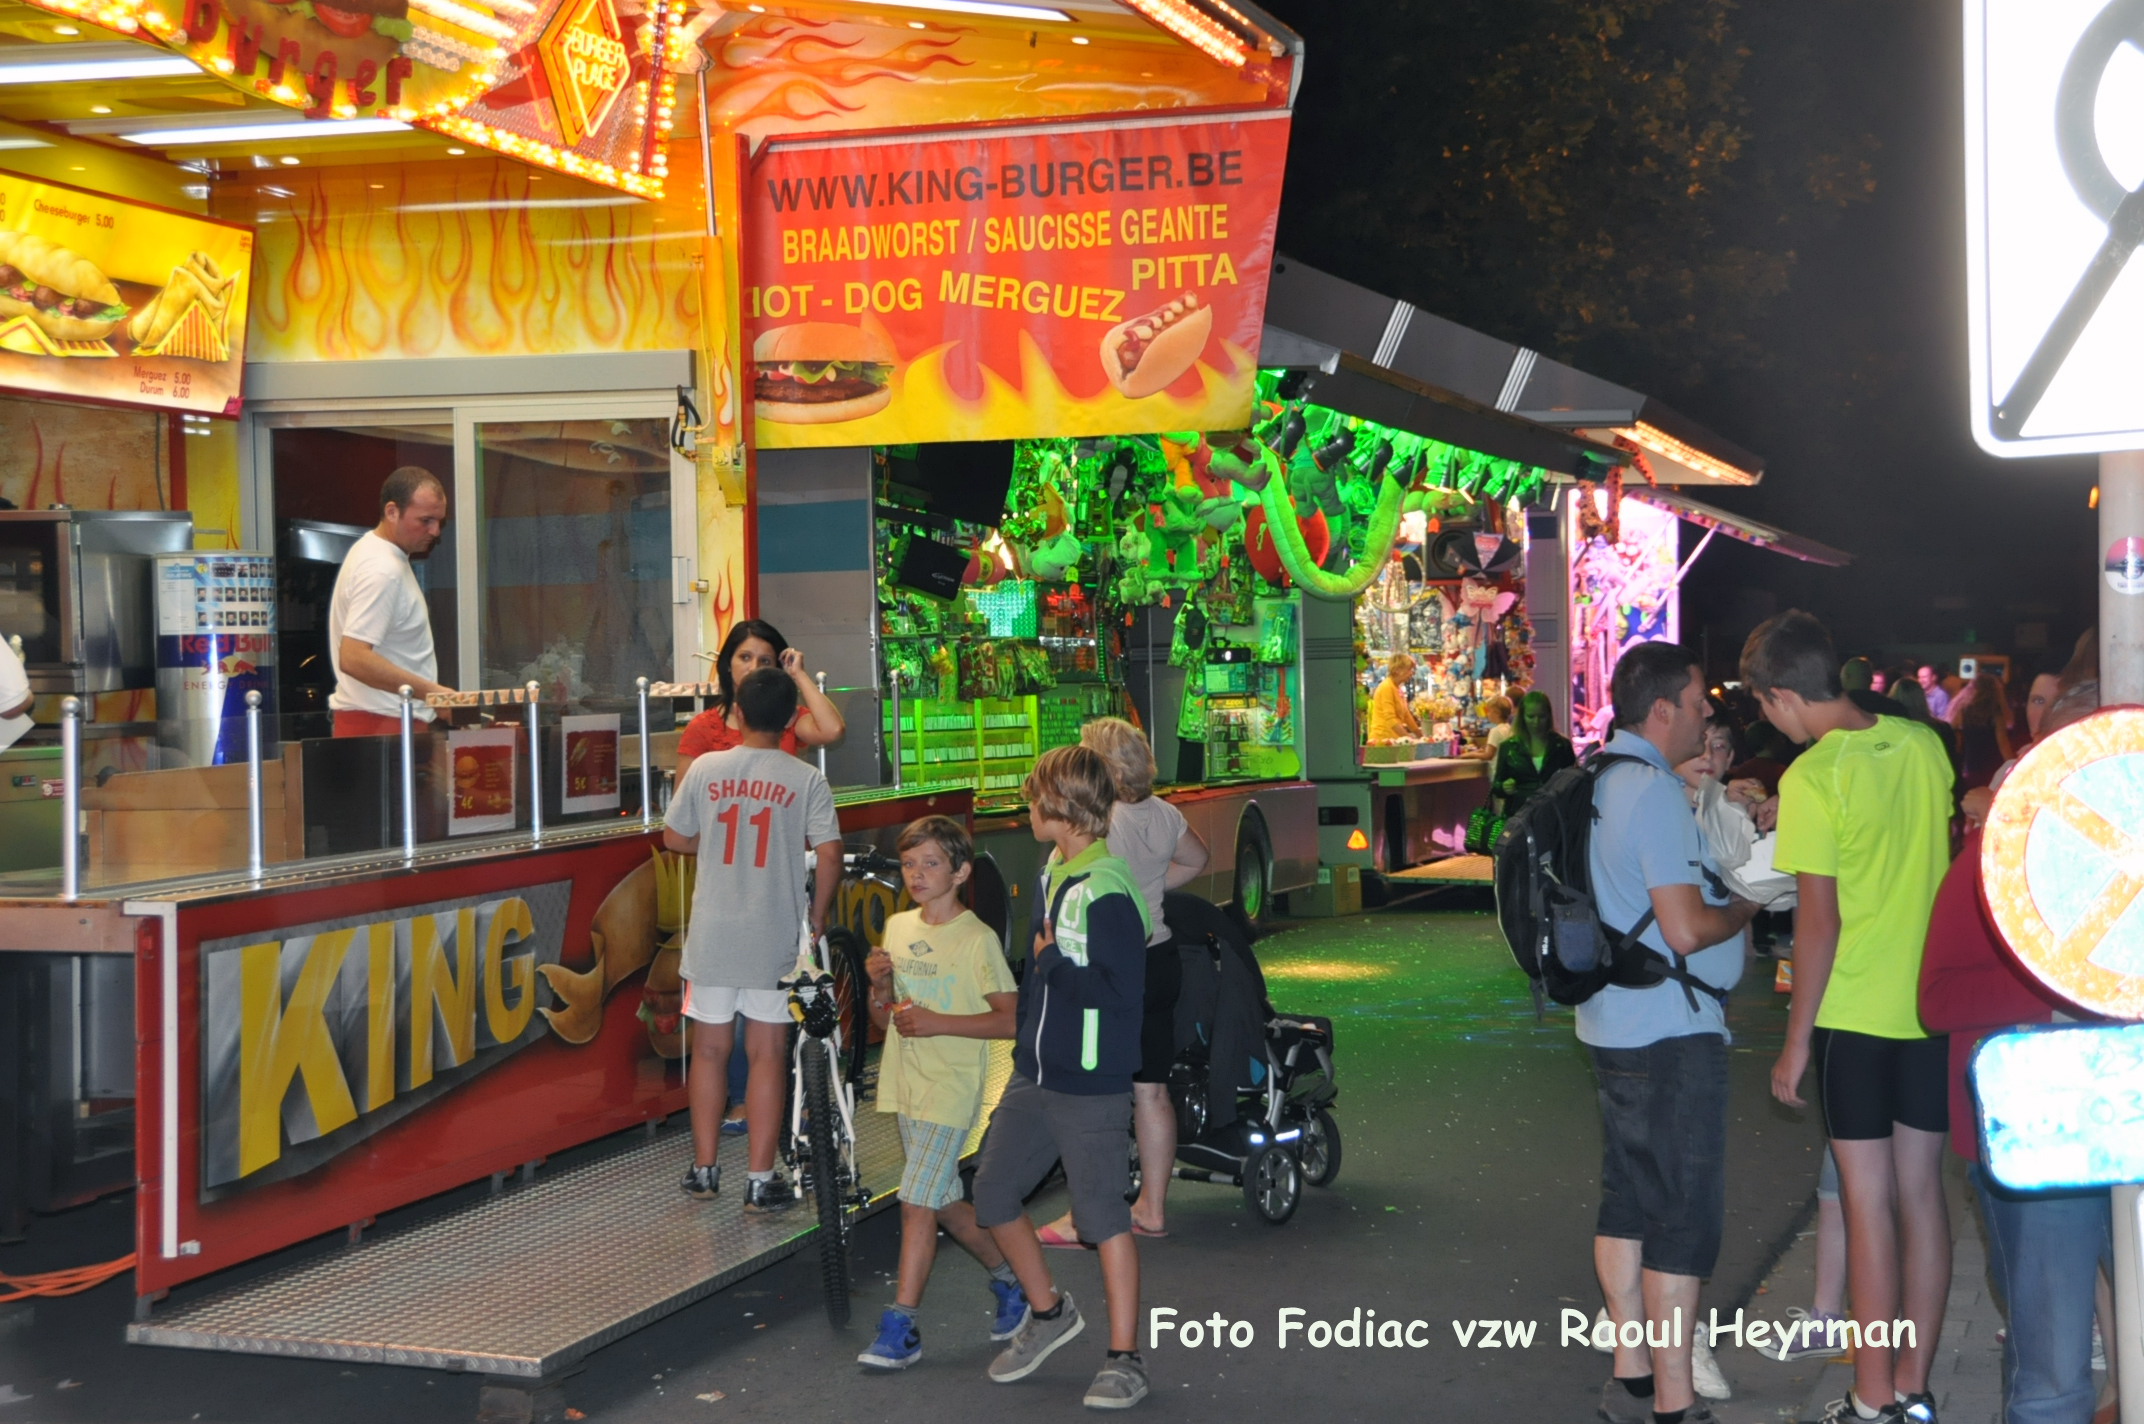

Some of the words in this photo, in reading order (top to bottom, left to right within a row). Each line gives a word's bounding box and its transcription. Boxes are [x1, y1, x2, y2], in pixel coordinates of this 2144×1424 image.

[571, 26, 625, 68] BURGER
[573, 57, 616, 91] PLACE
[767, 150, 1243, 213] WWW.KING-BURGER.BE
[34, 199, 90, 226] Cheeseburger
[783, 219, 960, 264] BRAADWORST
[967, 218, 977, 254] /
[984, 210, 1112, 254] SAUCISSE
[1120, 204, 1228, 245] GEANTE
[1132, 252, 1238, 291] PITTA
[844, 278, 922, 314] DOG
[939, 270, 1126, 323] MERGUEZ
[134, 366, 167, 383] Merguez
[140, 381, 164, 395] Durum
[181, 634, 230, 653] Red
[234, 634, 271, 653] Bull
[574, 777, 587, 791] 5€
[708, 779, 796, 808] SHAQIRI
[461, 796, 473, 810] 4€
[717, 803, 771, 868] 11
[239, 897, 536, 1179] KING
